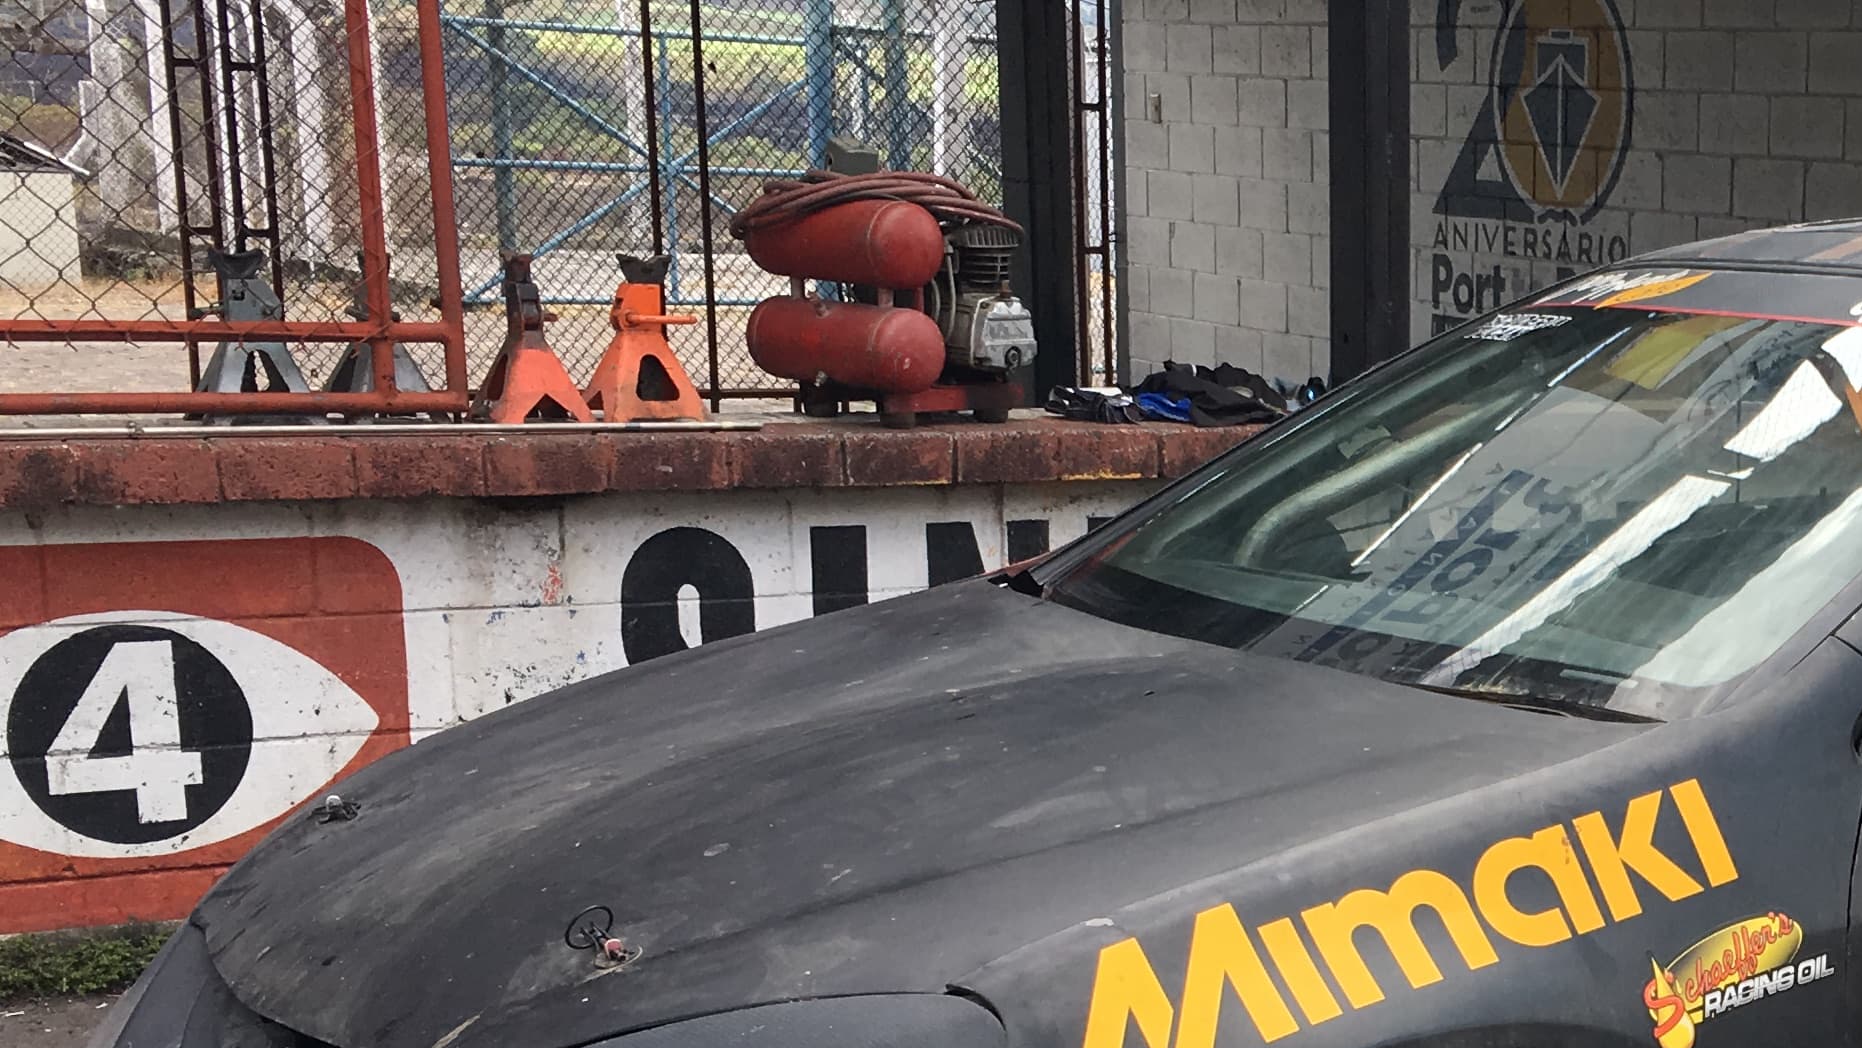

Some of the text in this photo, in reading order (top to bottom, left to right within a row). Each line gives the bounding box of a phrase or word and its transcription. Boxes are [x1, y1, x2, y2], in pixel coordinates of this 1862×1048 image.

[45, 640, 203, 823] 4
[1643, 912, 1794, 1039] Schaeffer's
[1704, 954, 1835, 1018] RACING OIL
